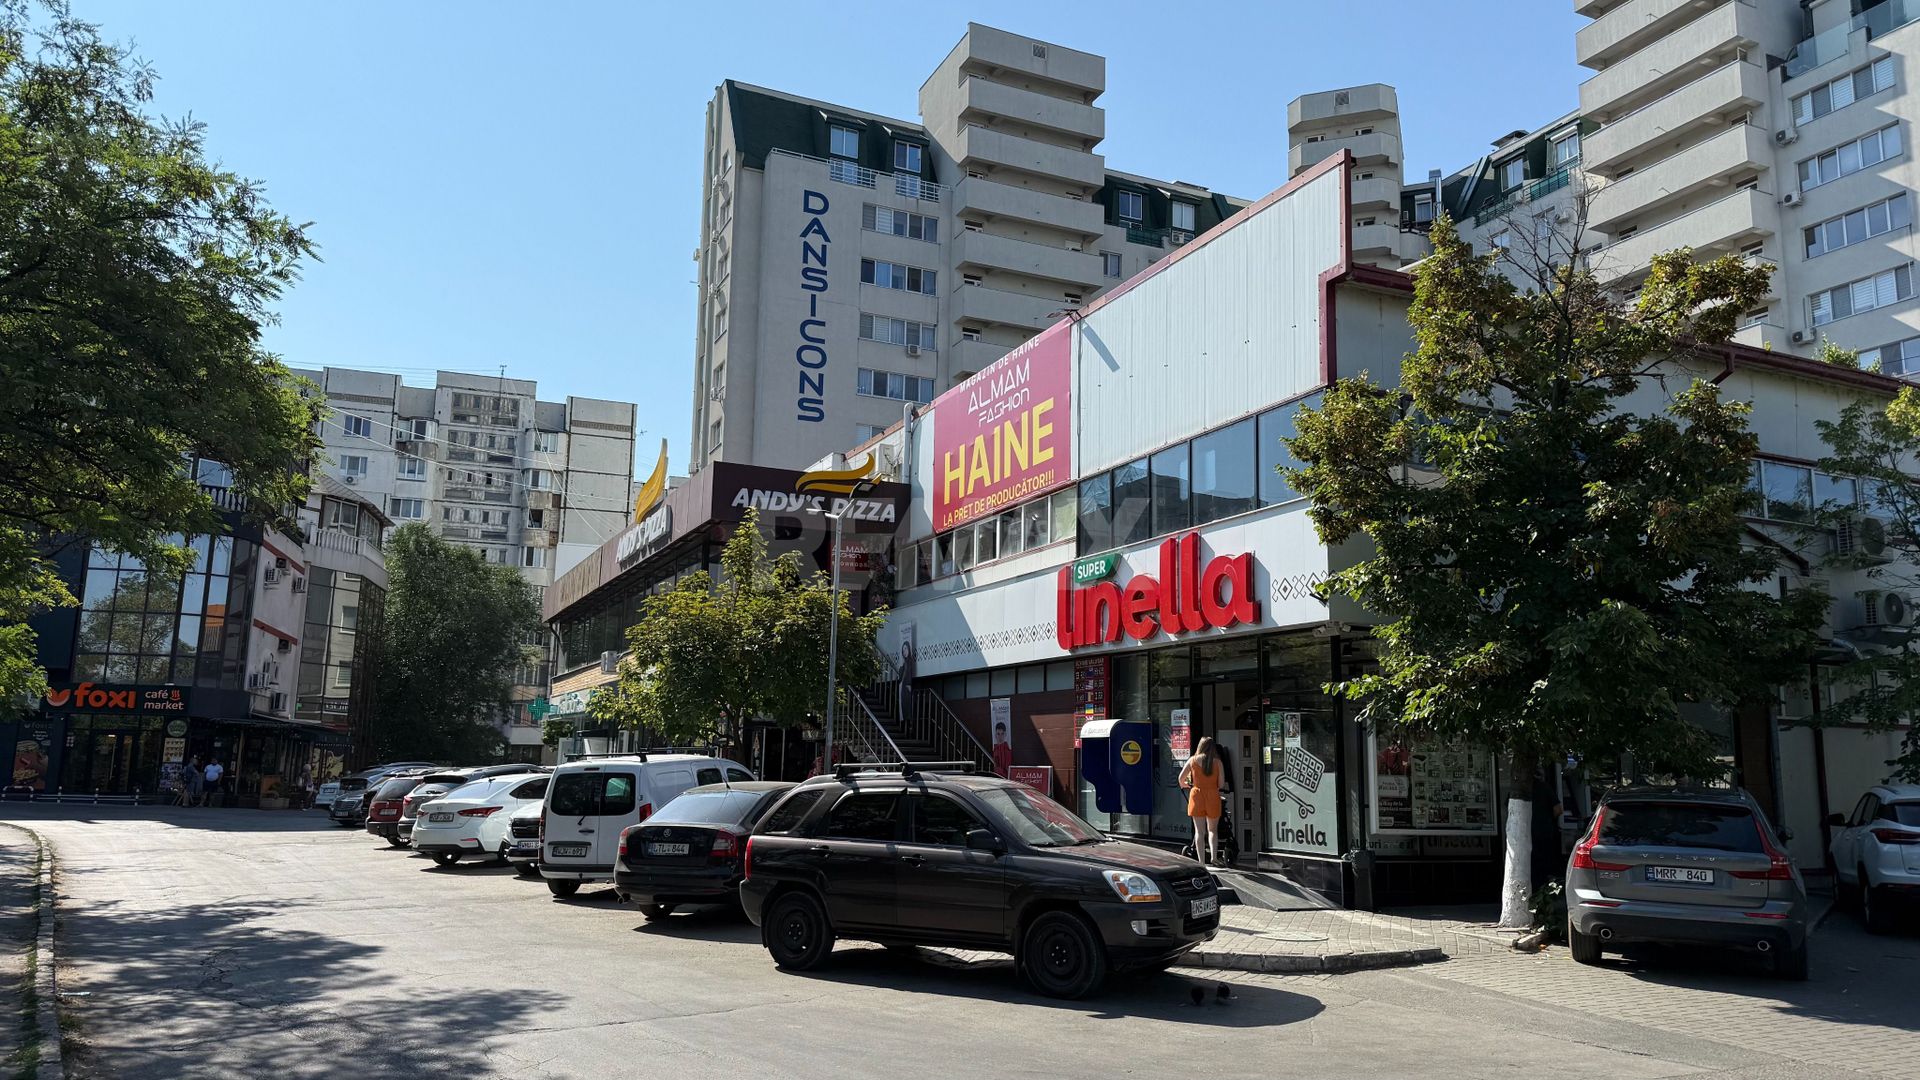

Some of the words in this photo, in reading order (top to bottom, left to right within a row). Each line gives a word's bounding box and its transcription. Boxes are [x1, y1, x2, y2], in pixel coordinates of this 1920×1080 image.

[796, 189, 831, 423] DANSICONS
[960, 362, 996, 393] MAGAZIN
[998, 354, 1009, 370] DE
[1012, 335, 1040, 361] HAINE
[968, 357, 1030, 416] ALMAM
[943, 396, 1055, 506] HAINE
[731, 487, 826, 516] ANDY'S
[831, 497, 896, 524] PIZZA
[943, 513, 953, 528] LA
[954, 503, 973, 521] PRET
[974, 501, 985, 513] DE
[1077, 560, 1106, 580] SUPER
[74, 681, 137, 710] foxi
[144, 700, 184, 711] market
[145, 688, 168, 699] café
[1275, 821, 1328, 848] linella
[1655, 868, 1677, 880] MRR
[1686, 869, 1707, 881] 840
